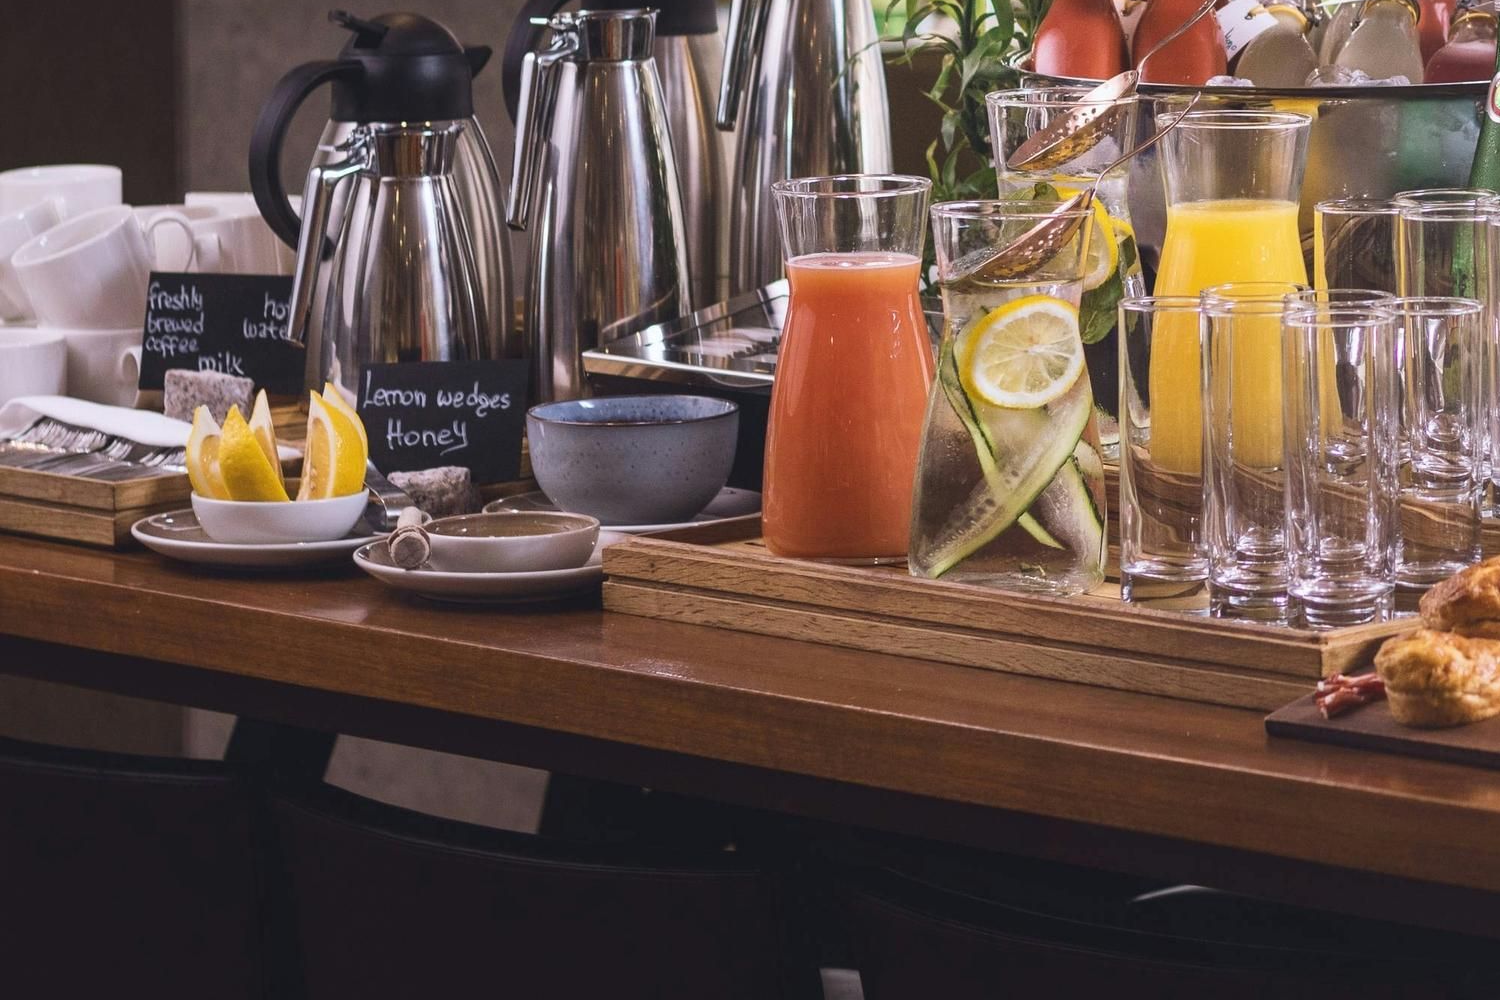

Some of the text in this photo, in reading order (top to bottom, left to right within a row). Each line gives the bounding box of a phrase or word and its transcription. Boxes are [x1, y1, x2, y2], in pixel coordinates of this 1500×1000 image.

[148, 311, 204, 334] brewed
[243, 317, 290, 340] wate
[145, 335, 199, 358] coffee
[198, 351, 245, 375] milk
[363, 370, 511, 418] Lemon wedges
[386, 418, 468, 456] Honey
